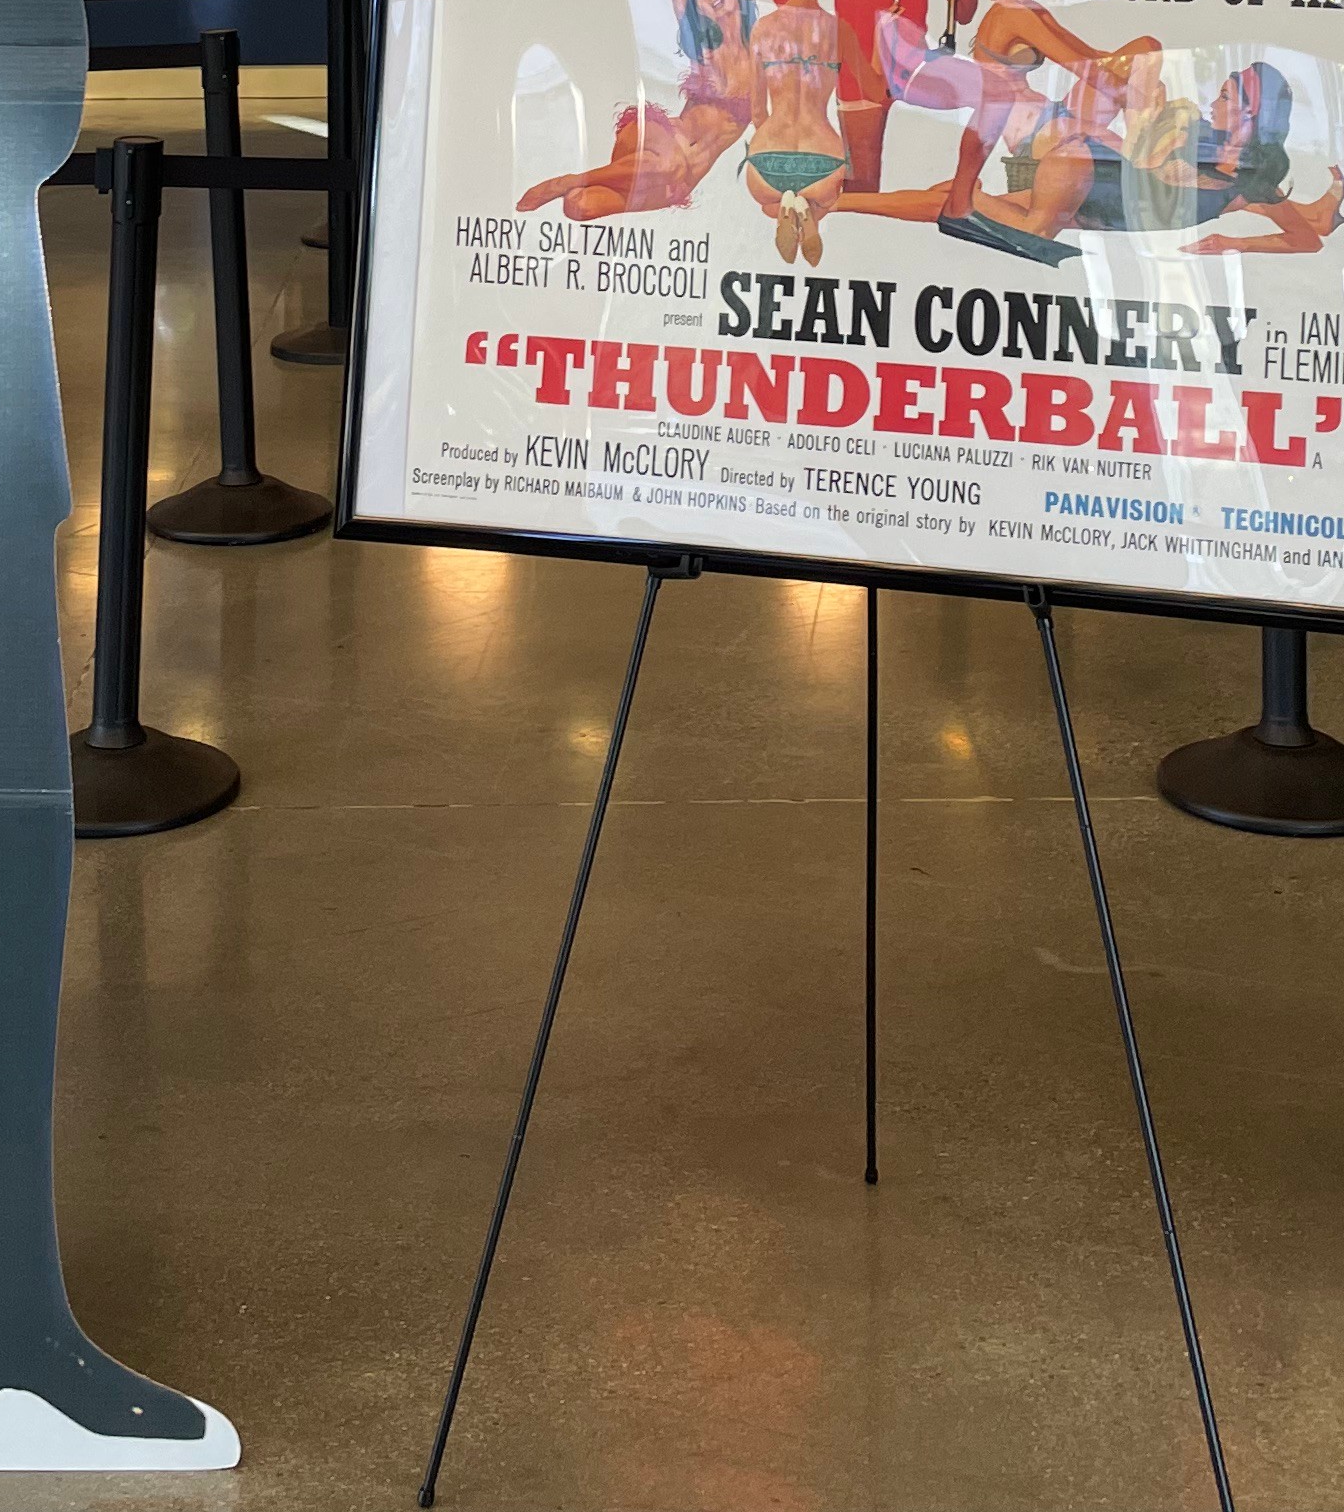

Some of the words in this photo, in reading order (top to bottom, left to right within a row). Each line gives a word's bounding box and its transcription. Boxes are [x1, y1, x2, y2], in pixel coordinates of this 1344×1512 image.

[456, 216, 526, 251] HARRY
[539, 221, 654, 262] SALTZMAN
[668, 232, 709, 264] and
[469, 252, 552, 289] ALBERT
[566, 258, 586, 291] R.
[598, 260, 708, 300] BROCCOLI
[663, 311, 703, 328] present
[718, 270, 898, 348] SEAN
[914, 284, 1257, 376] CONNERY
[1265, 320, 1288, 345] in
[1300, 311, 1341, 348] IAN
[441, 442, 499, 464] Produced
[504, 445, 518, 467] by
[525, 435, 589, 470] KEVIN
[604, 441, 710, 481] McCLORY
[720, 467, 774, 488] Directed
[780, 470, 795, 493] by
[804, 467, 897, 498] TERENCE
[907, 476, 982, 506] YOUNG
[657, 421, 721, 442] CLAUDINE
[726, 427, 771, 447] AUGER
[787, 432, 841, 453] ADOLFO
[846, 438, 876, 456] CELI
[894, 441, 951, 462] LUCIANA
[957, 446, 1014, 468] PALUZZI
[1032, 454, 1056, 472] RIK
[1062, 456, 1089, 475] VAN
[1096, 461, 1152, 480] NUTTER
[412, 468, 480, 492] Screenplay
[485, 473, 499, 493] by
[504, 475, 560, 496] RICHARD
[564, 481, 623, 501] MAIBAUM
[632, 486, 642, 502] &
[646, 487, 682, 506] JOHN
[687, 491, 746, 513] HOPKINS
[755, 498, 797, 518] Based
[803, 505, 821, 520] on
[827, 505, 850, 523] the
[856, 508, 909, 530] original
[916, 513, 952, 535] story
[959, 515, 975, 536] by
[988, 519, 1033, 540] KEVIN
[1040, 524, 1115, 550] McCLORY,
[1120, 534, 1158, 552] JACK
[1164, 537, 1277, 563] WHITTINGHAM
[1283, 548, 1311, 567] and
[1317, 551, 1344, 569] IAN
[1044, 491, 1184, 525] PANAVISION
